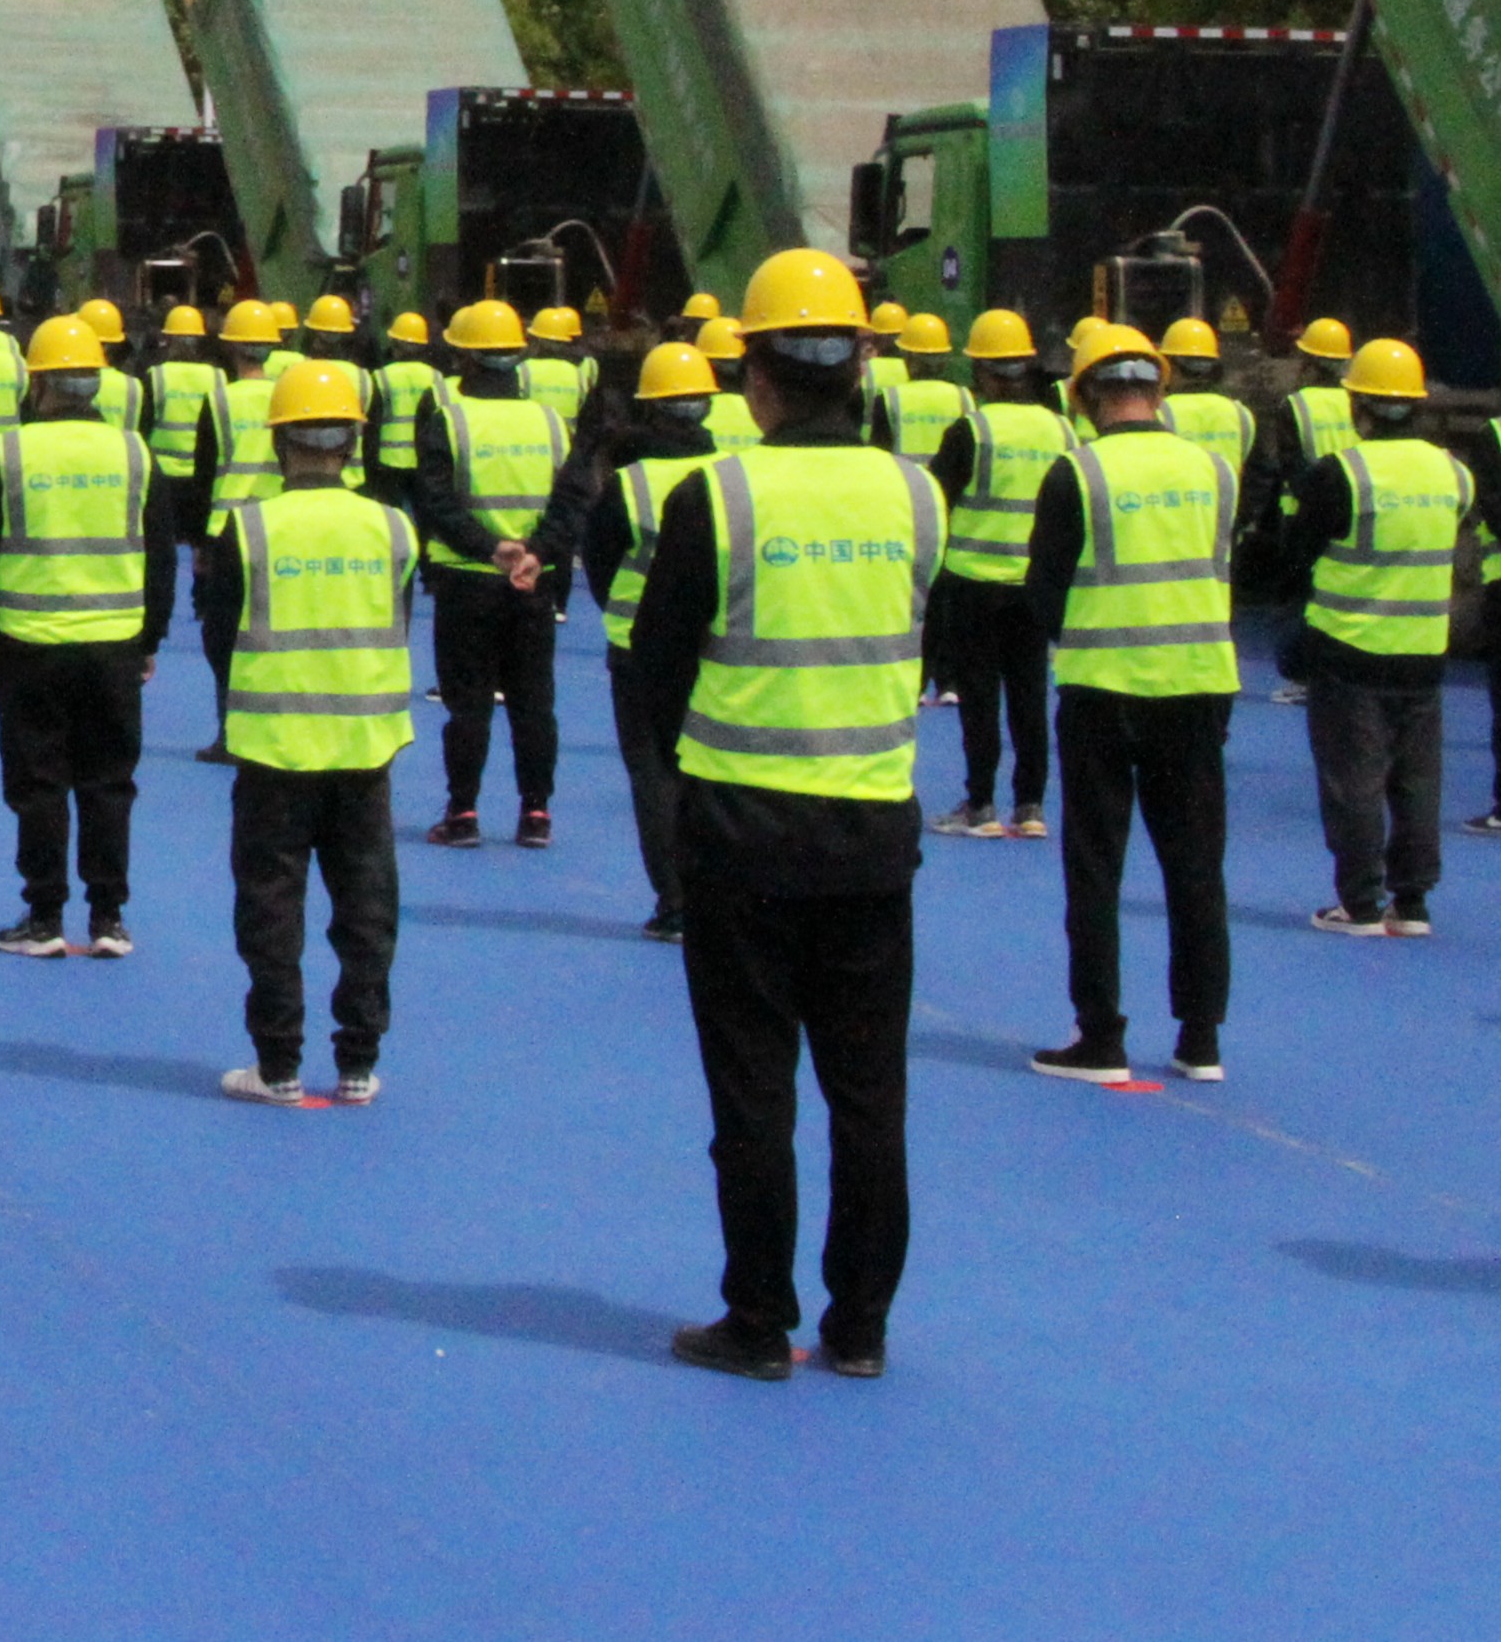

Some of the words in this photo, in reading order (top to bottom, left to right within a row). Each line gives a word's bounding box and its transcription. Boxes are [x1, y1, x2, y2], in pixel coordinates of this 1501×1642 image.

[804, 538, 906, 564] 中国中铁
[306, 557, 384, 575] 中国中铁
